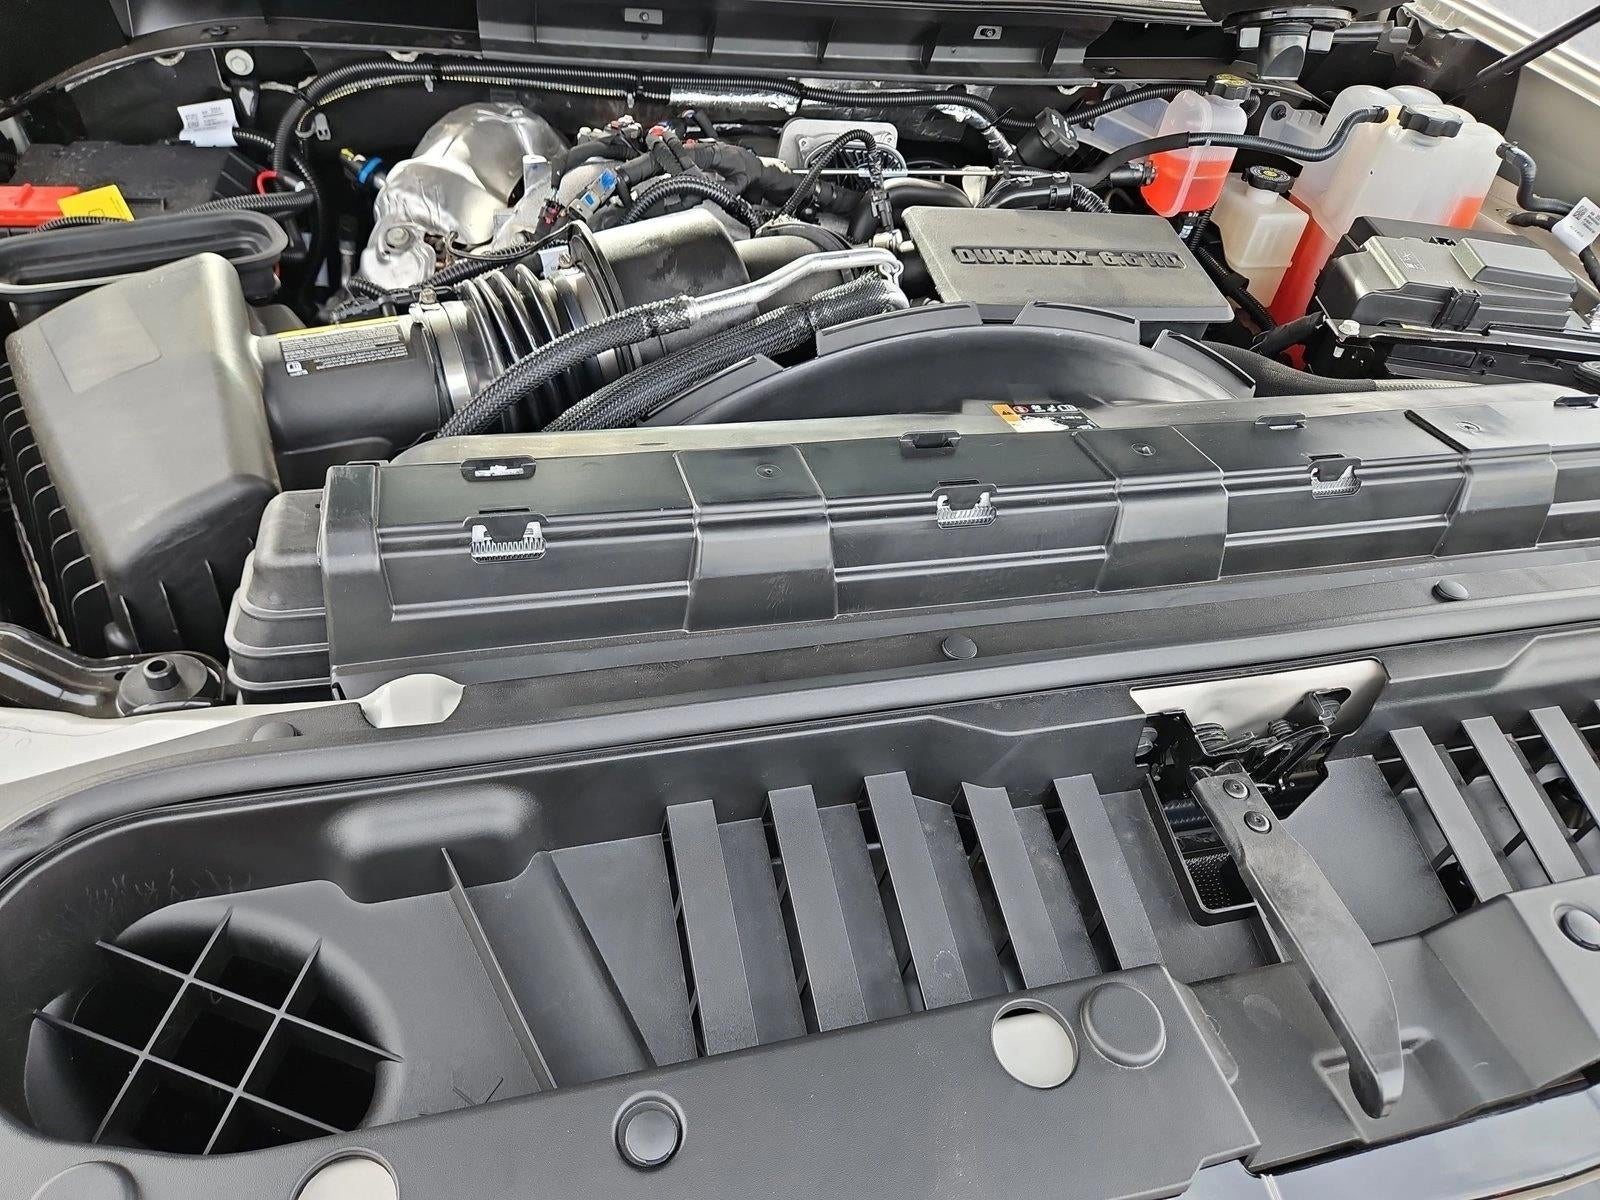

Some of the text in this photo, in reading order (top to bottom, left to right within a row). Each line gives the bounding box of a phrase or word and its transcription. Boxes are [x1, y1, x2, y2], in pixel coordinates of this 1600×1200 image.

[954, 248, 1182, 269] DURAMAX 6.6 HD
